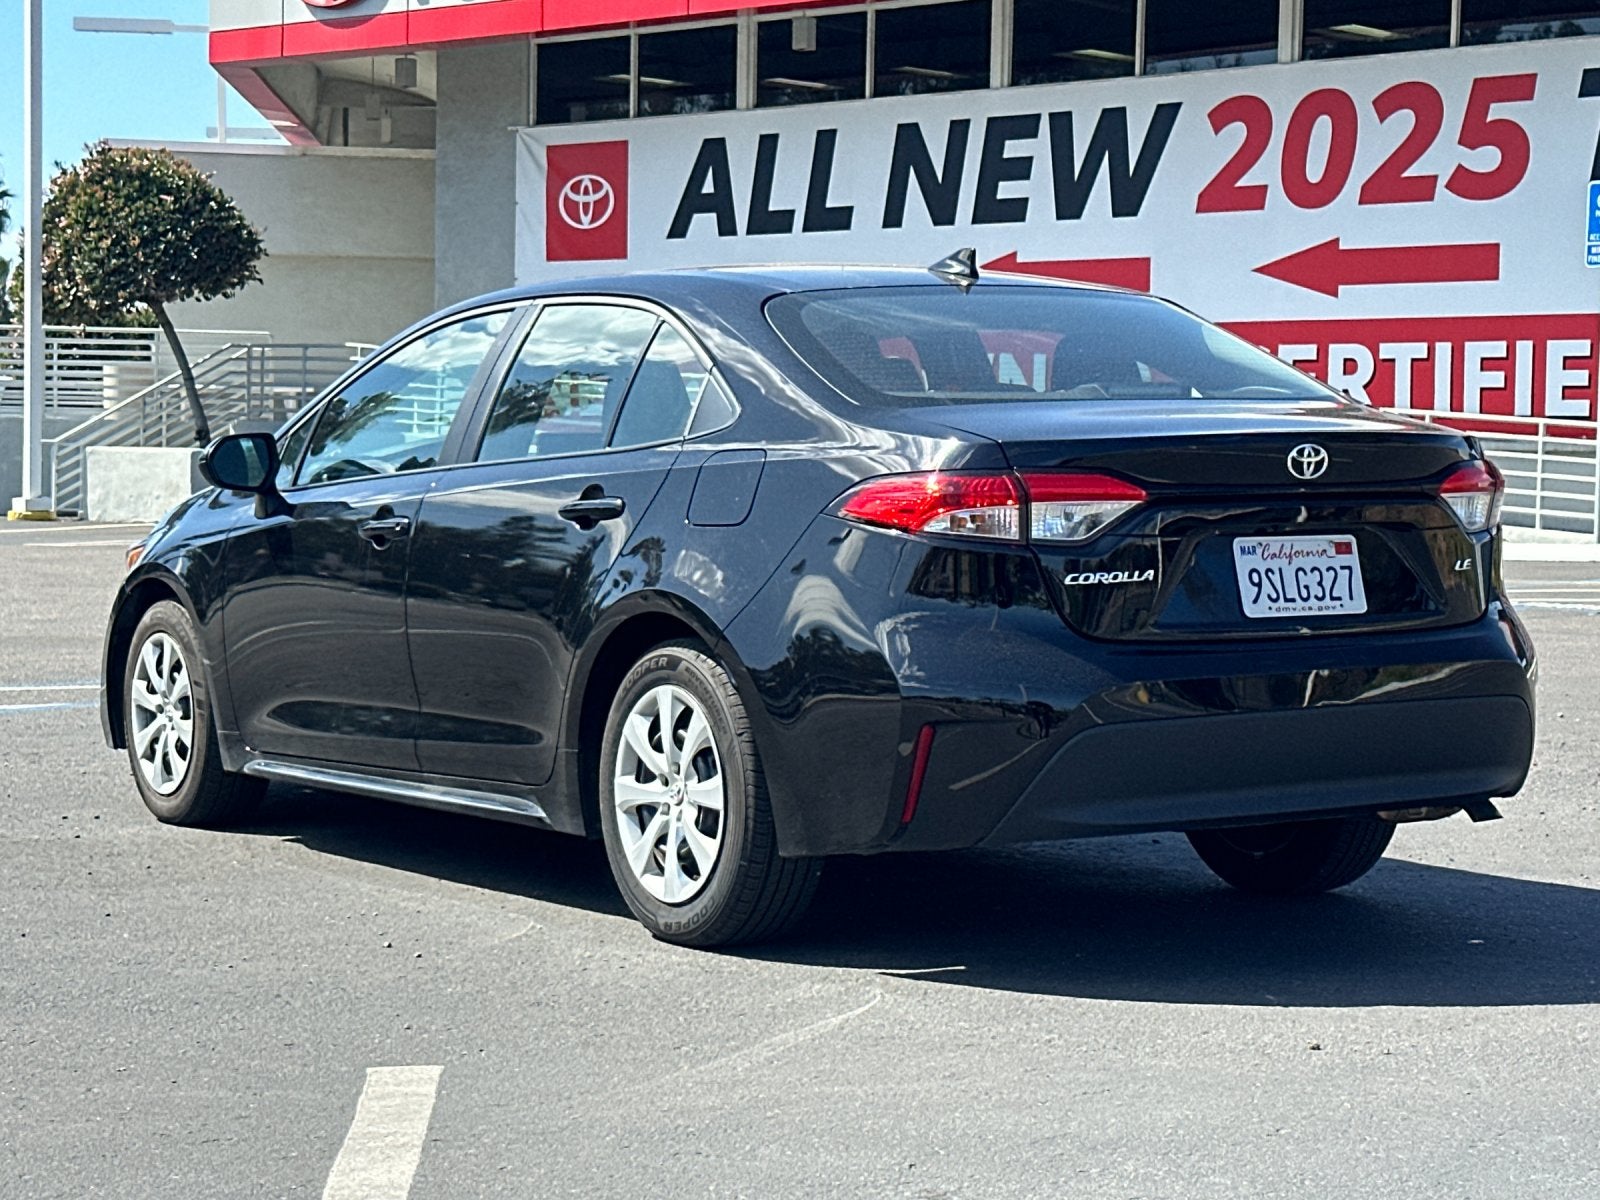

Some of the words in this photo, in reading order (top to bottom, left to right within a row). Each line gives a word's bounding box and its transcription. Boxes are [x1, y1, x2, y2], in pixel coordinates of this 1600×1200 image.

[666, 129, 855, 240] ALL
[881, 102, 1183, 229] NEW
[1196, 73, 1538, 214] 2025
[1259, 340, 1592, 418] RTIFIE
[1240, 545, 1258, 555] MAR
[1261, 543, 1336, 566] California
[1454, 558, 1472, 571] LE
[1063, 569, 1155, 585] COROLLA
[1248, 565, 1354, 605] 9SLG327
[619, 656, 669, 698] COOPER
[662, 896, 715, 931] COOPER
